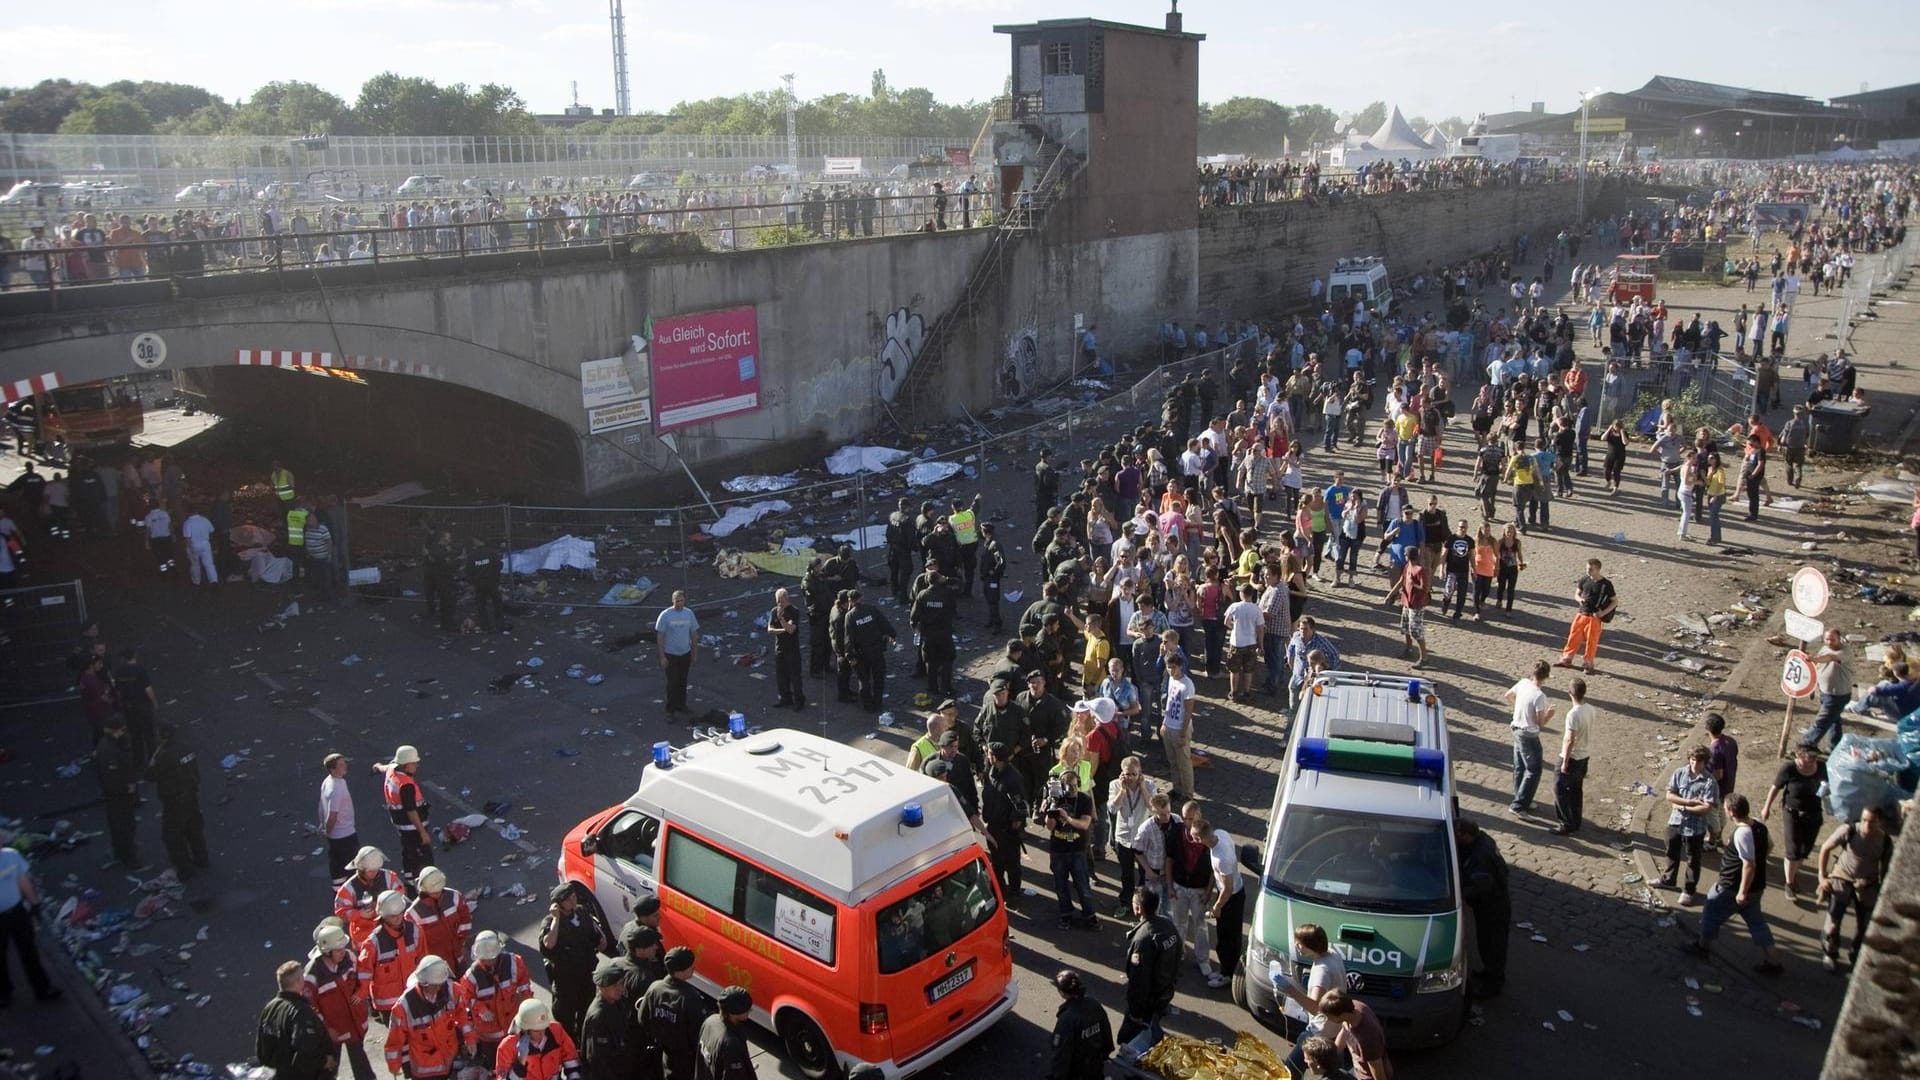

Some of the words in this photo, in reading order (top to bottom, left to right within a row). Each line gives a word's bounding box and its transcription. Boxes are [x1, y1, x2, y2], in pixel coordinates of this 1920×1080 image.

[659, 334, 672, 345] Aus
[672, 324, 705, 342] Gleich
[689, 342, 706, 354] wird
[707, 329, 751, 351] Sofort:
[755, 747, 832, 778] MH
[798, 760, 895, 805] 2317
[667, 890, 708, 925] FEUER
[721, 918, 785, 965] NOTFALL
[655, 1007, 677, 1023] POLIZEI
